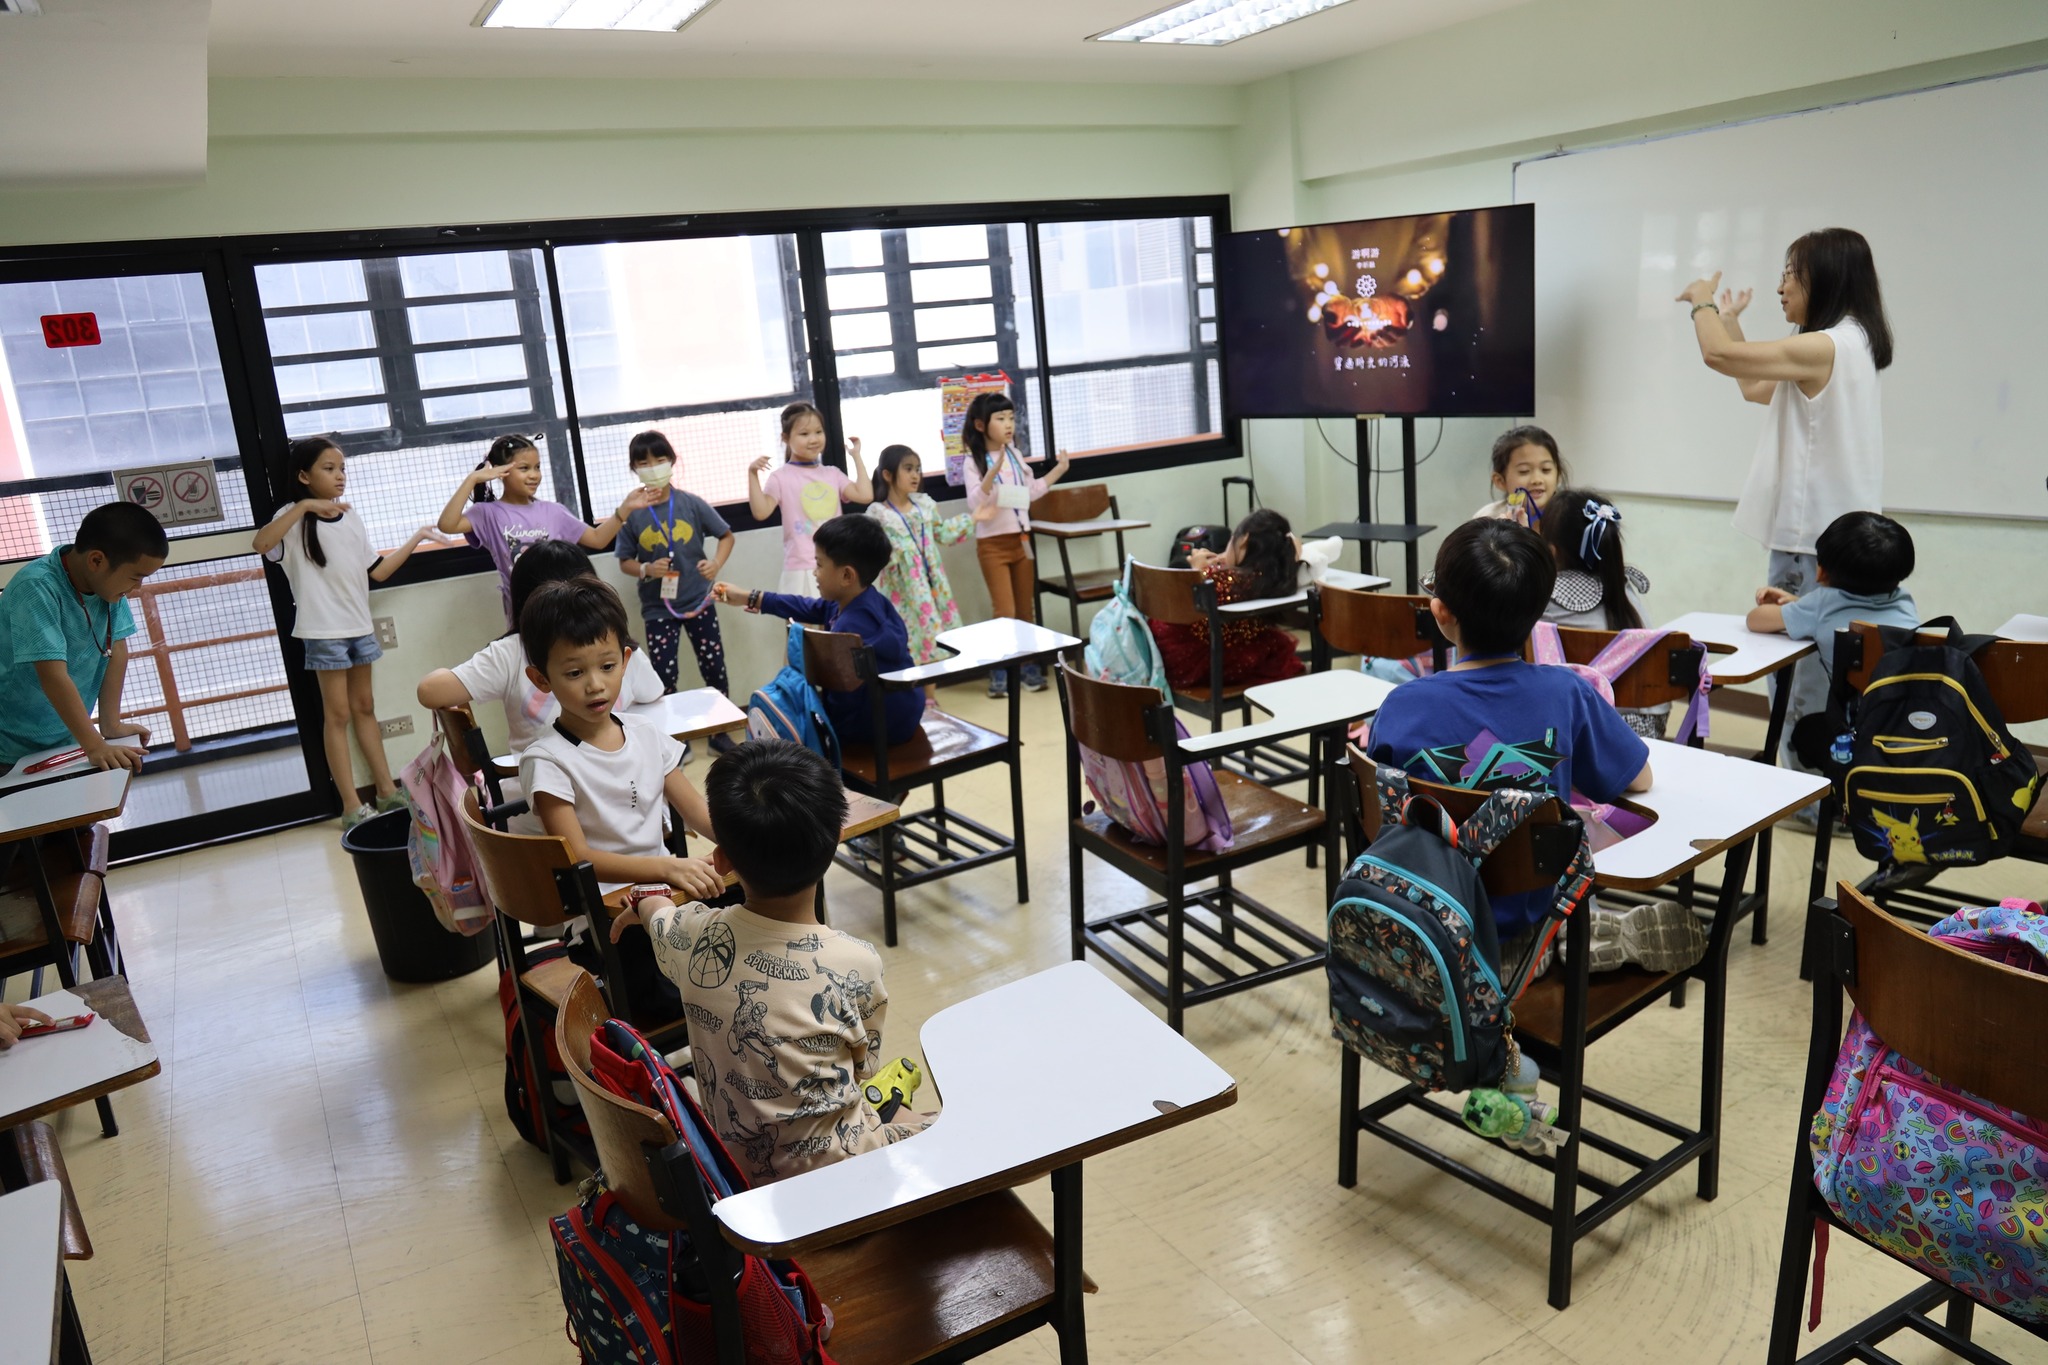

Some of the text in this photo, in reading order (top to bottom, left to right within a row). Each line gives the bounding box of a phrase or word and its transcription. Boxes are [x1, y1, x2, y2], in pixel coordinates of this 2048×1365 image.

[503, 524, 549, 541] Kuromi
[744, 953, 810, 981] SPIDER-MAN
[762, 952, 802, 968] AMAZING
